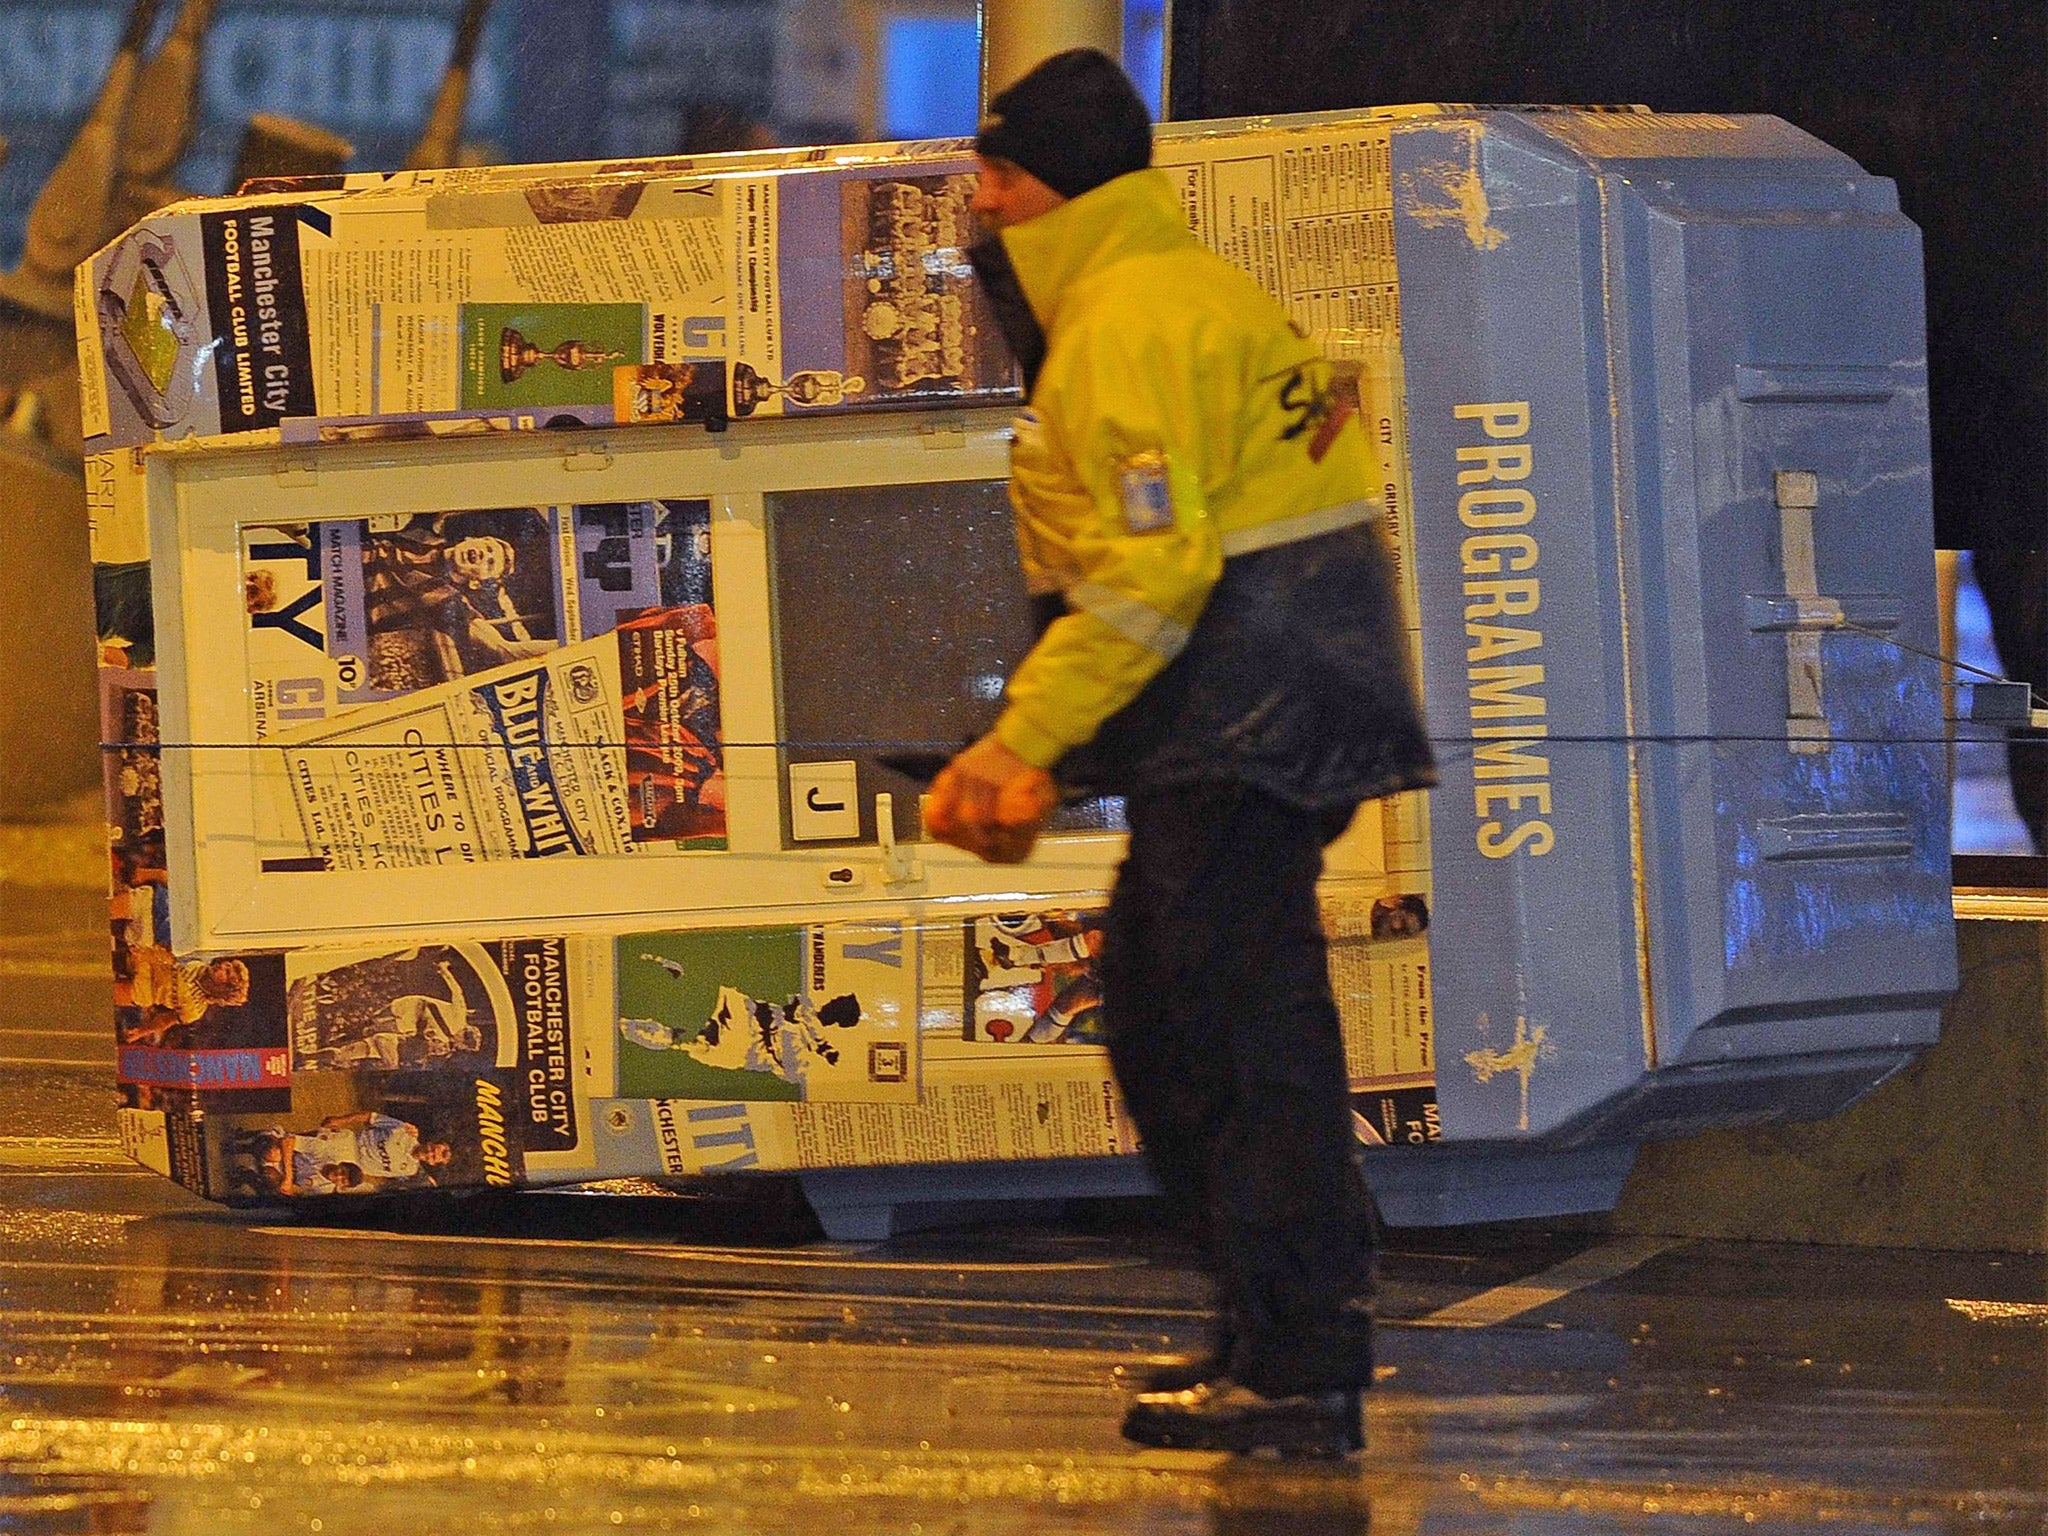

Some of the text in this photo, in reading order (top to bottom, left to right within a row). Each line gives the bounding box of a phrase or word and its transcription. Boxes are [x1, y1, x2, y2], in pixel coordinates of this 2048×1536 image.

[761, 184, 770, 243] MANCHESTER
[1186, 168, 1200, 231] For a really
[734, 185, 745, 356] OFFICIAL PROGRAMME ONE SHILLING
[746, 184, 758, 312] League Division Championship
[249, 216, 290, 411] Manchester City
[764, 270, 772, 314] FOOTBALL
[222, 219, 254, 415] FOOTBALL CLUB LIMITED
[765, 318, 773, 340] CLUB
[1379, 417, 1392, 445] CITY
[559, 516, 570, 533] First
[1383, 482, 1399, 537] GRIMSBY
[561, 535, 572, 566] Division
[329, 528, 348, 642] MATCH MAGAZINE
[565, 599, 577, 641] September
[1451, 400, 1556, 860] PROGRAMMES
[652, 629, 665, 677] Barclays
[663, 628, 676, 670] Sunday
[676, 636, 688, 677] Fulham
[656, 678, 669, 723] Premier
[666, 671, 678, 697] 25th
[495, 674, 546, 767] BLUE
[524, 762, 540, 789] AND
[668, 699, 682, 742] October
[296, 758, 317, 804] CITIES
[345, 749, 375, 828] CITIES
[402, 726, 446, 832] CITIES
[434, 748, 457, 800] WHERE
[451, 810, 465, 832] TO
[607, 782, 618, 793] &
[806, 786, 844, 812] J
[573, 796, 590, 823] CITY
[811, 932, 824, 991] WANDERERS
[521, 952, 548, 1123] FOOTBALL CLUB
[539, 937, 569, 1137] MANCHESTER CITY
[1100, 1080, 1115, 1129] Grimsby
